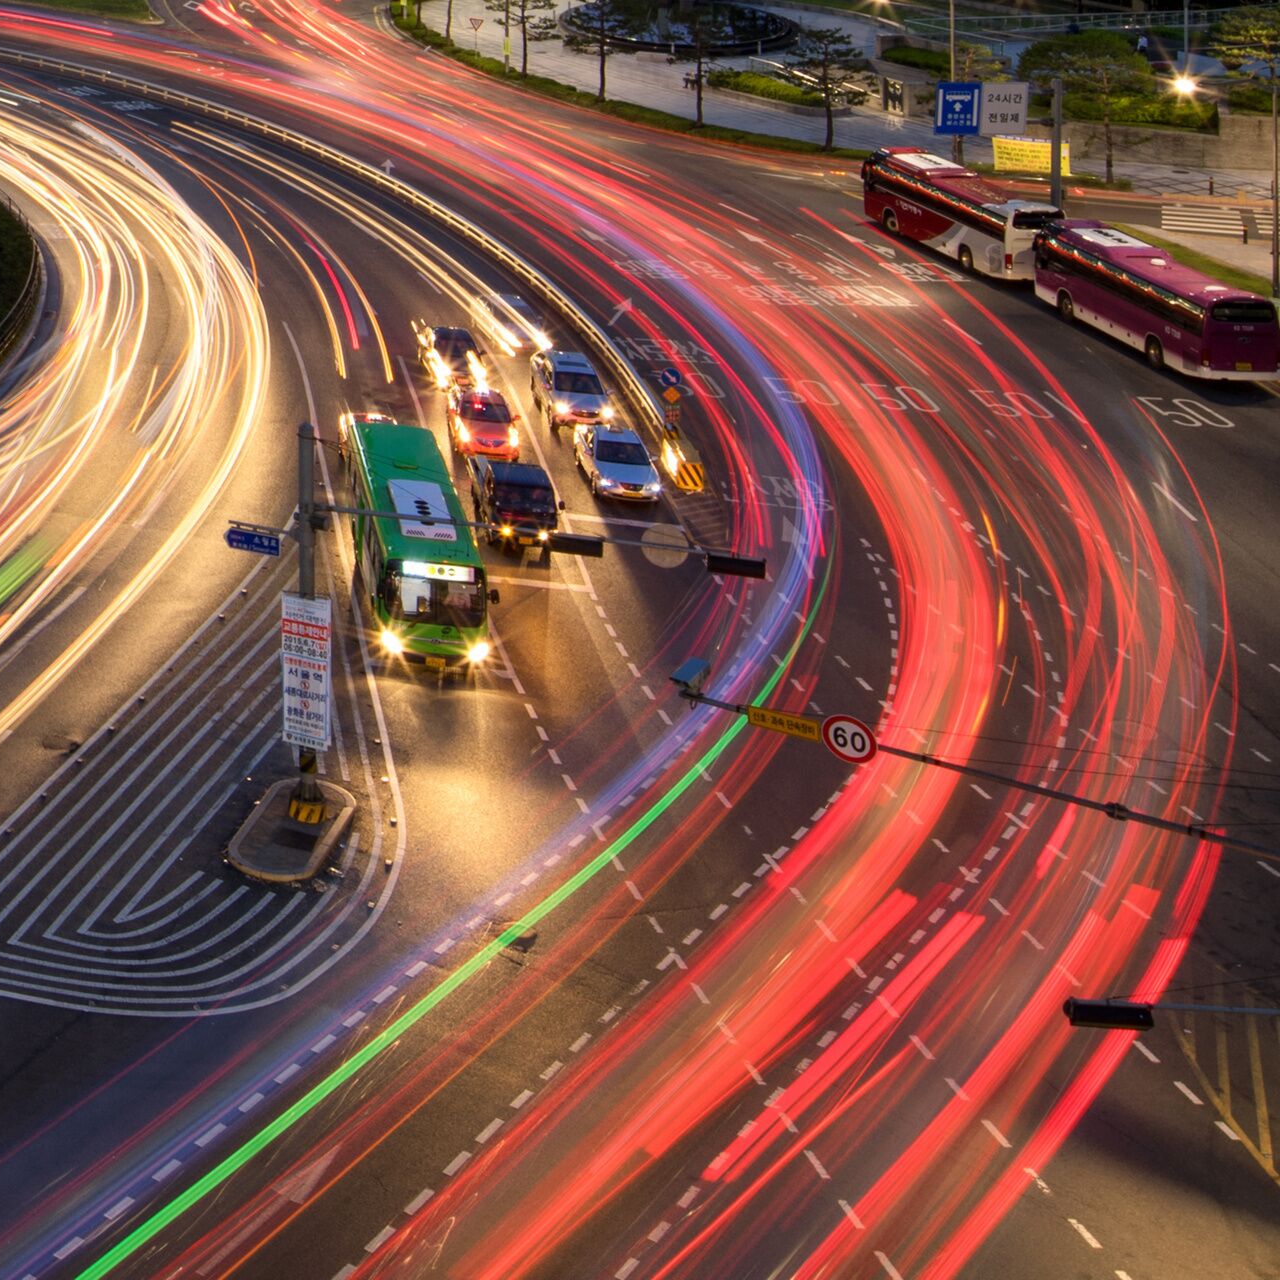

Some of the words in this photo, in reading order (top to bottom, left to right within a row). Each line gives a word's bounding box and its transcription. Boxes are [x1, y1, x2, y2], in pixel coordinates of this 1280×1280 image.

[987, 93, 1023, 105] 24시간
[988, 112, 1020, 123] 전일제
[772, 261, 865, 282] 용산
[763, 376, 840, 406] 50
[861, 383, 941, 413] 50
[968, 388, 1055, 419] 50
[1136, 395, 1236, 429] 50
[252, 534, 277, 547] 소월로
[833, 726, 866, 753] 60
